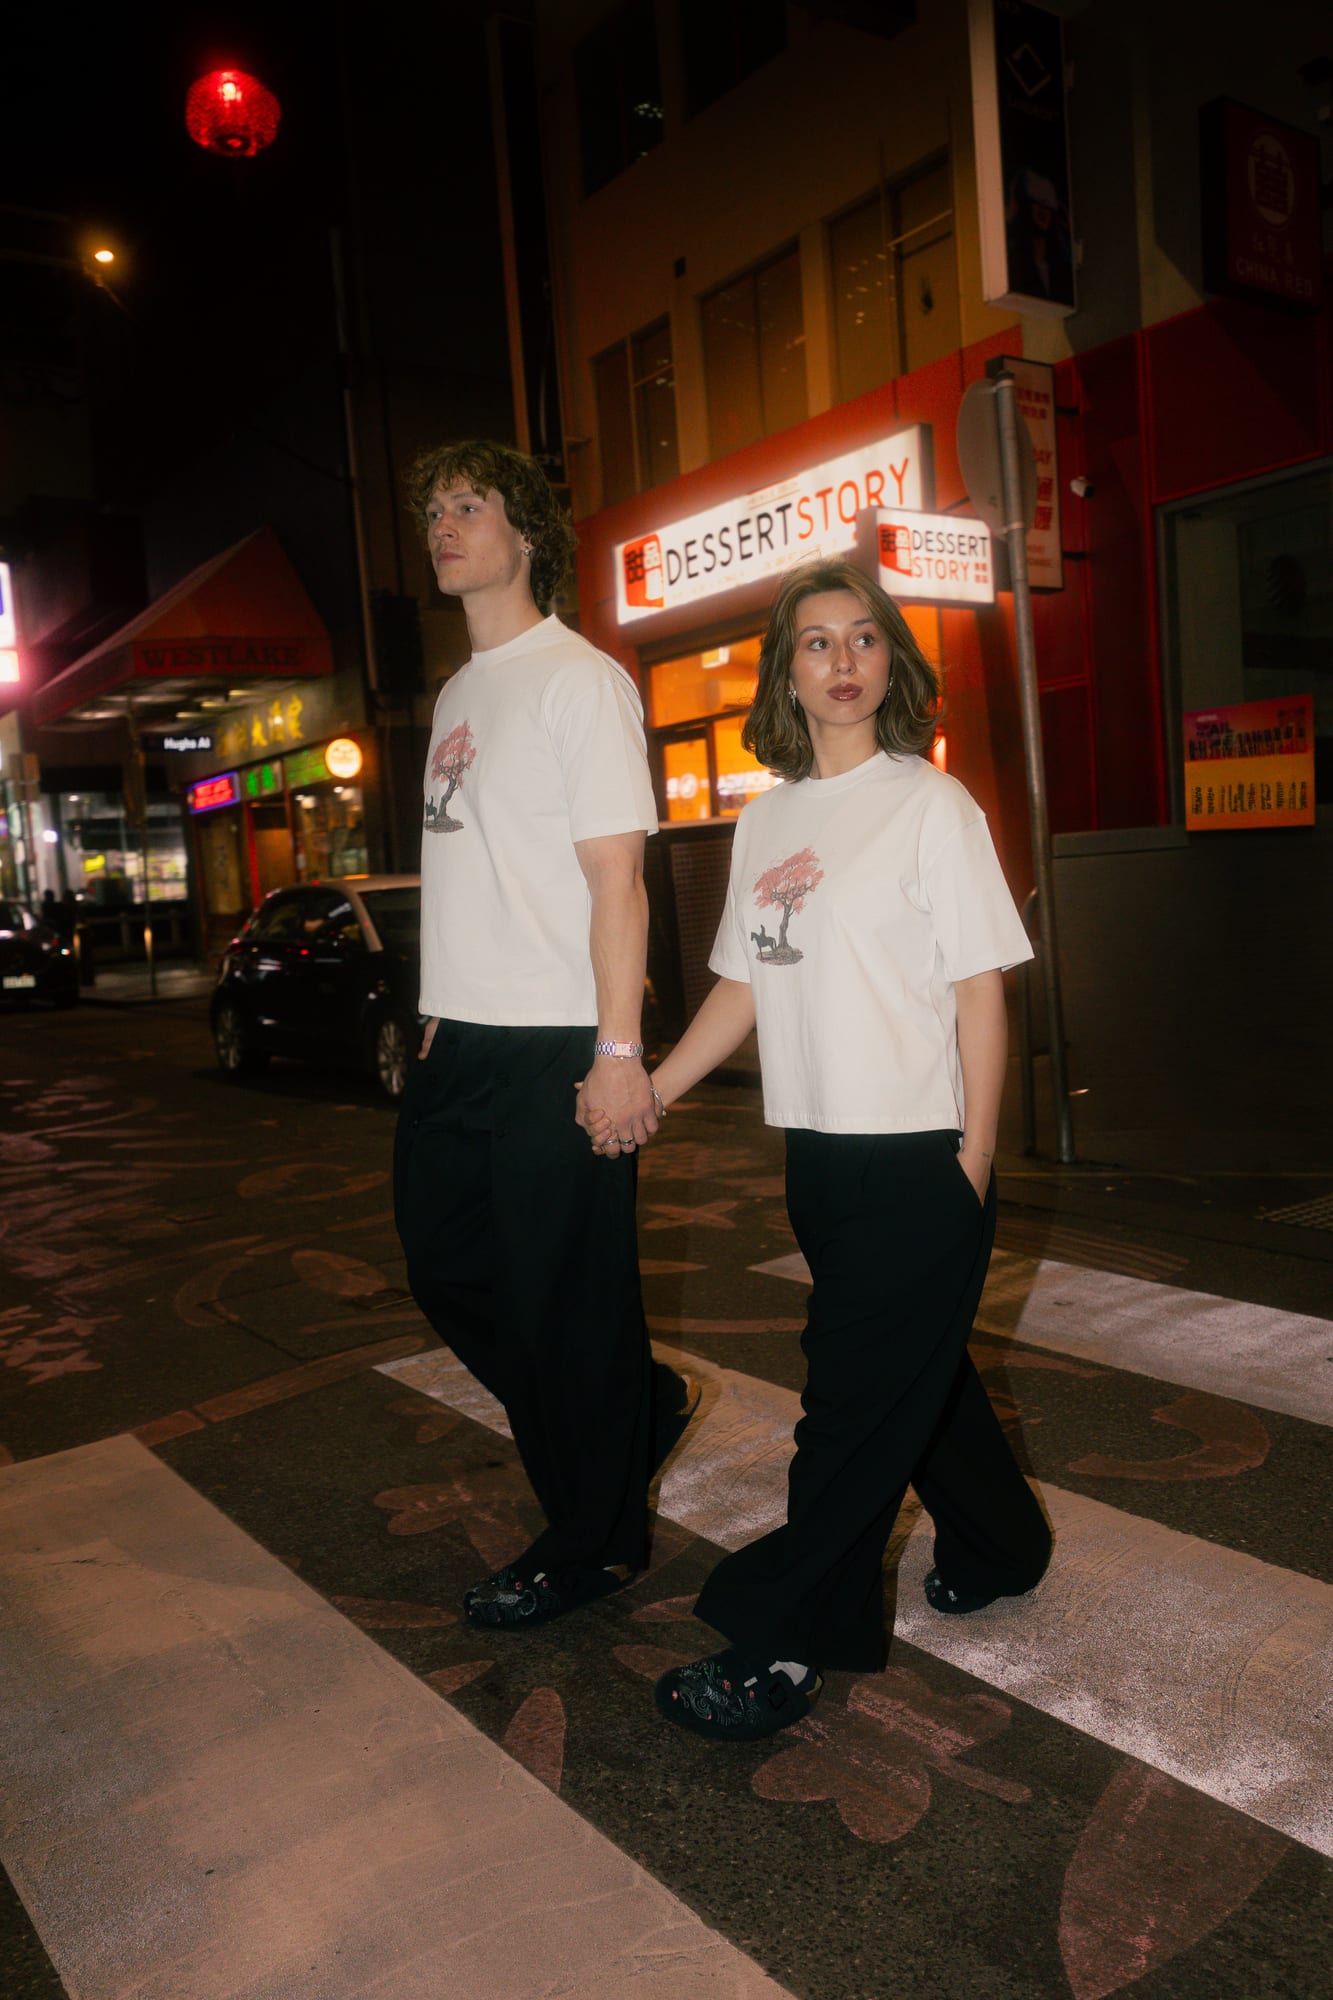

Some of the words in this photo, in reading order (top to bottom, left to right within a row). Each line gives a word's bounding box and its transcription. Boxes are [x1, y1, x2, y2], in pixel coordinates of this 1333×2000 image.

[666, 502, 793, 586] DESSERT
[796, 457, 909, 540] STORY
[911, 529, 989, 557] DESSERT
[911, 556, 969, 583] STORY
[141, 644, 303, 670] WESTLAKE
